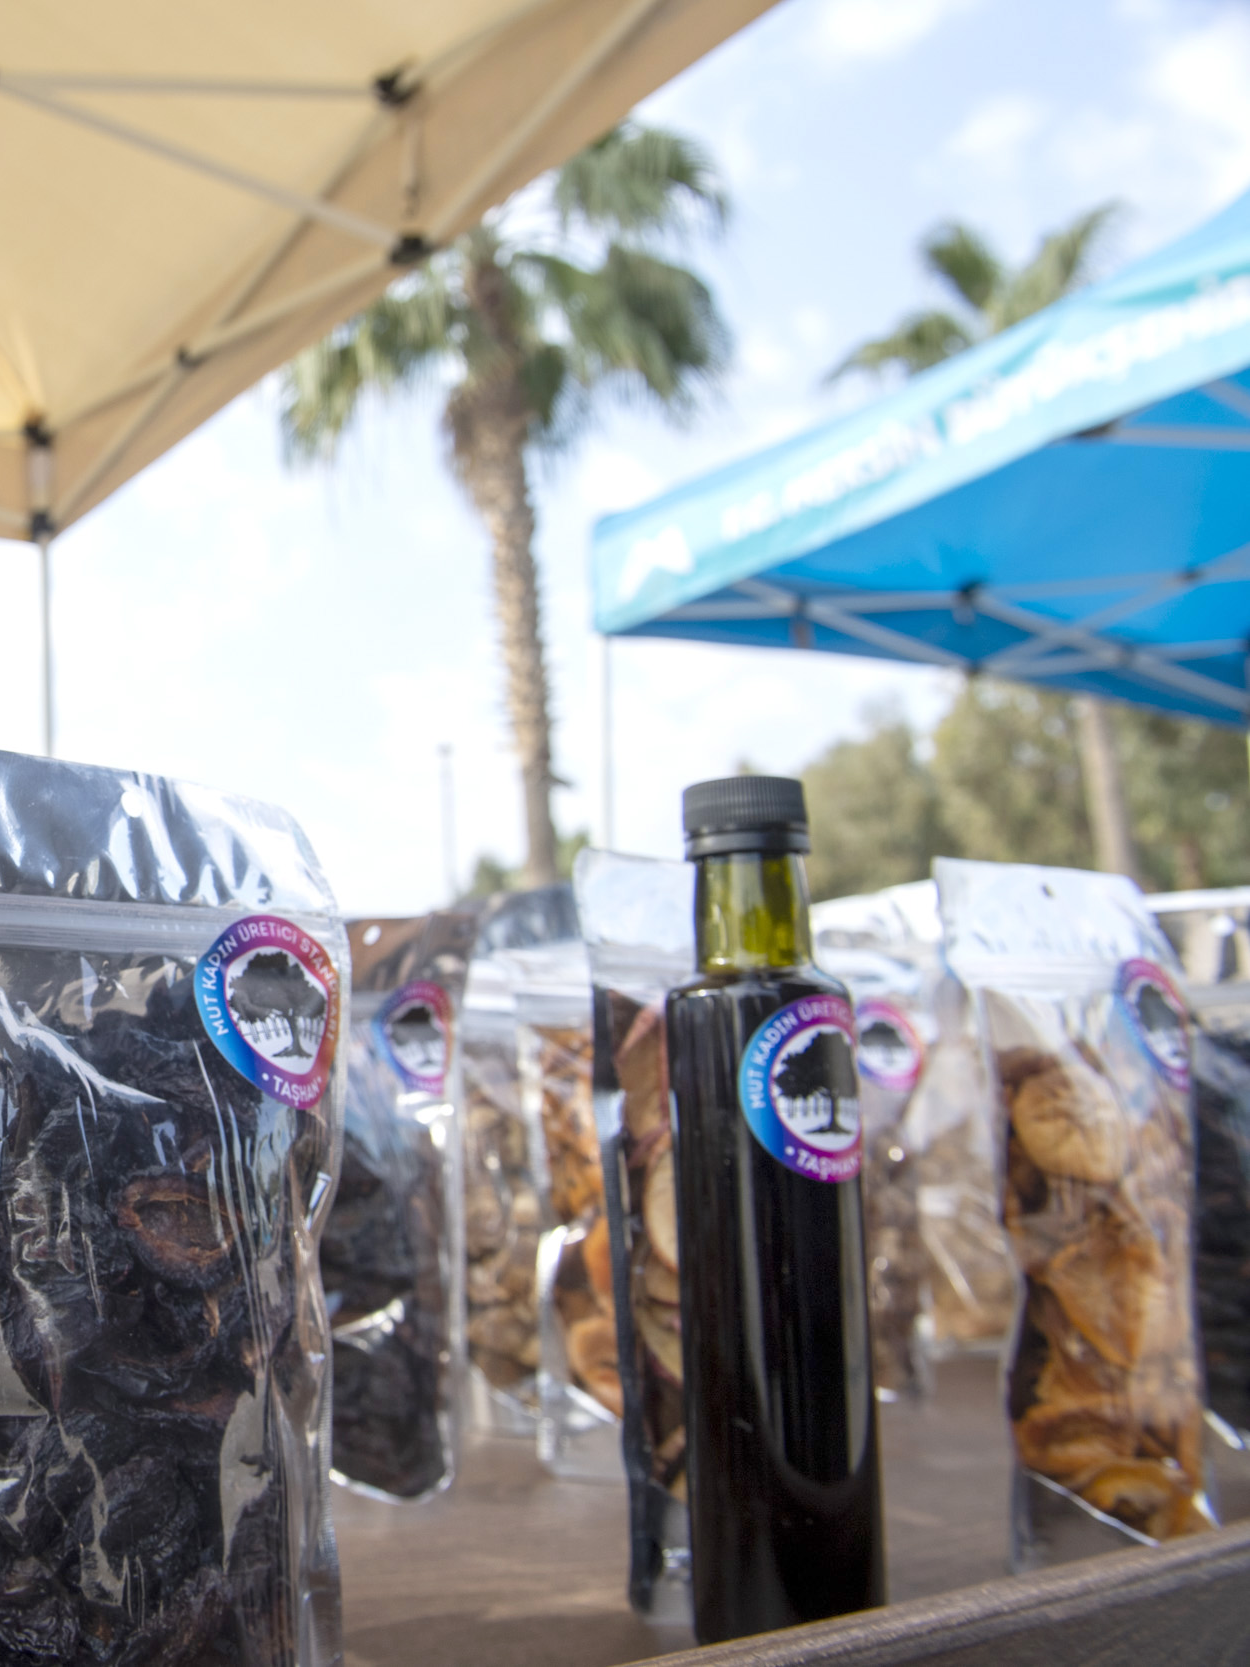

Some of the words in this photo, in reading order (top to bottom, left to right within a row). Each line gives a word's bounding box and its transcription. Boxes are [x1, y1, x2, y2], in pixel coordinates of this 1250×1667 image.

[202, 935, 239, 991] KADIN
[204, 995, 230, 1036] MUT
[752, 1011, 799, 1066] KADIN
[273, 1075, 320, 1107] TAŞHAN
[747, 1069, 766, 1109] MUT
